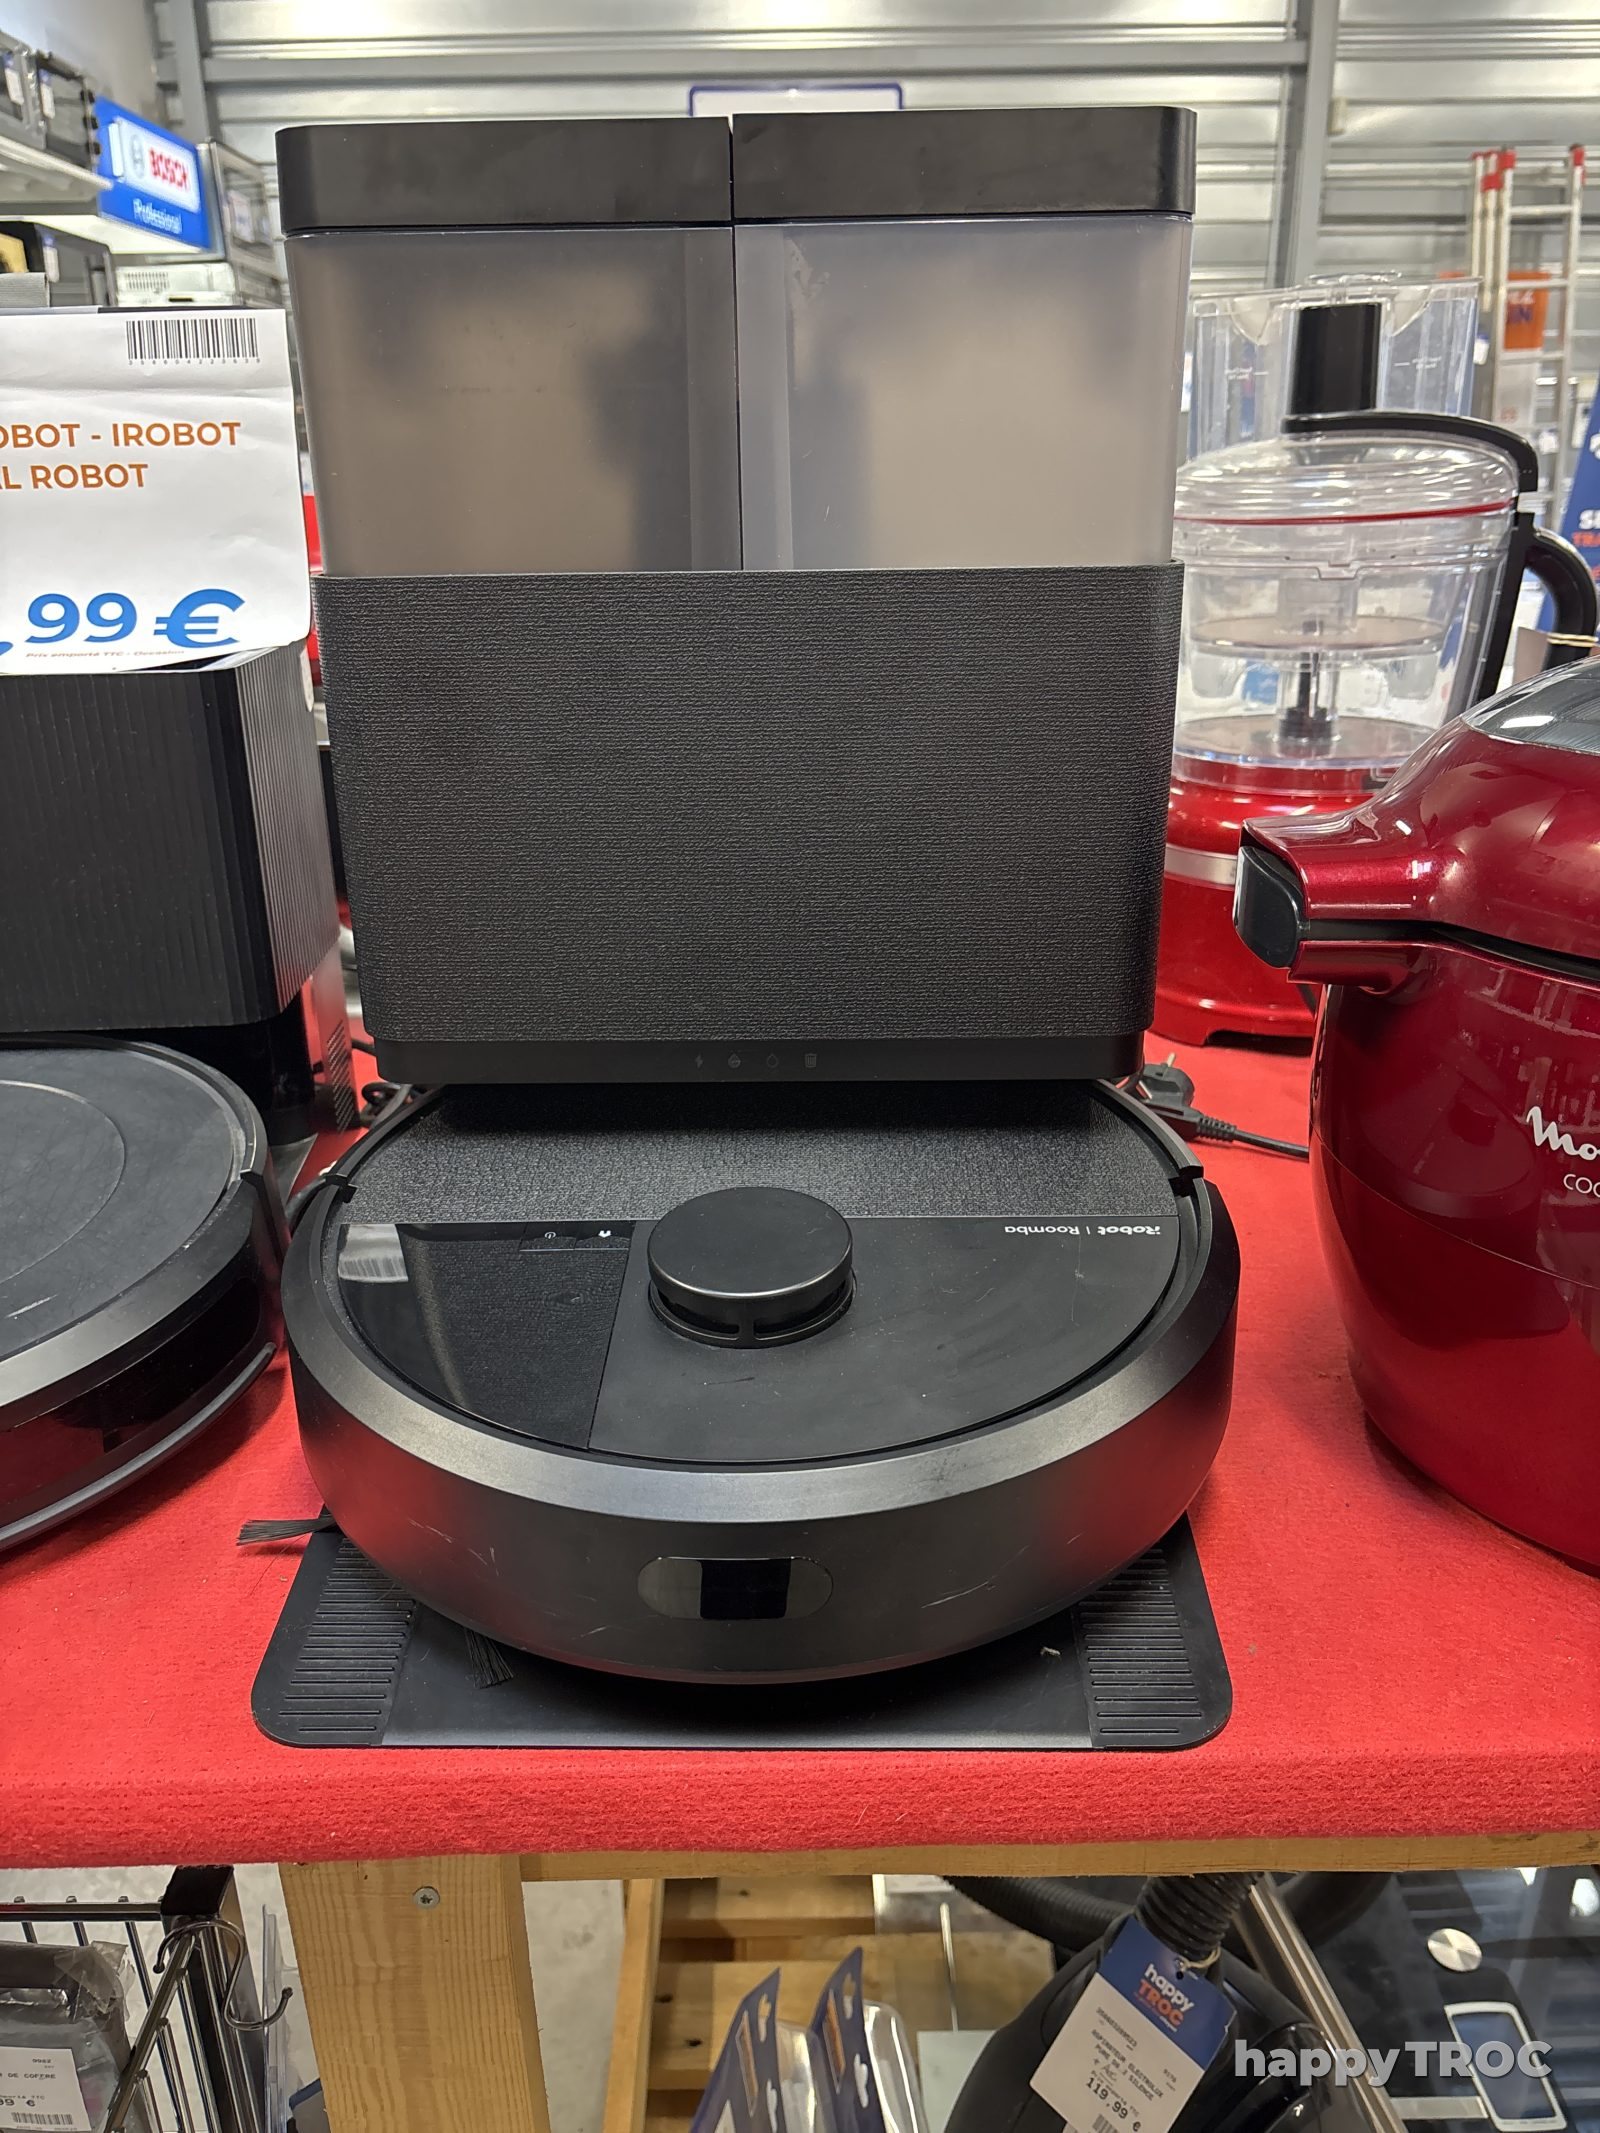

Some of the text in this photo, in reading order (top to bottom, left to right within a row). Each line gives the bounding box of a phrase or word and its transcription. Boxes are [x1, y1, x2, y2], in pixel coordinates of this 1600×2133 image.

[149, 147, 190, 191] BOSCH
[112, 422, 241, 447] IROBOT
[0, 463, 148, 490] L ROBOT
[154, 587, 246, 648] €
[1004, 1225, 1080, 1236] Roomba
[1097, 1225, 1161, 1236] iRobot
[1144, 1964, 1195, 2012] happy
[1138, 1979, 1183, 2026] TROC
[1132, 2121, 1142, 2132] €
